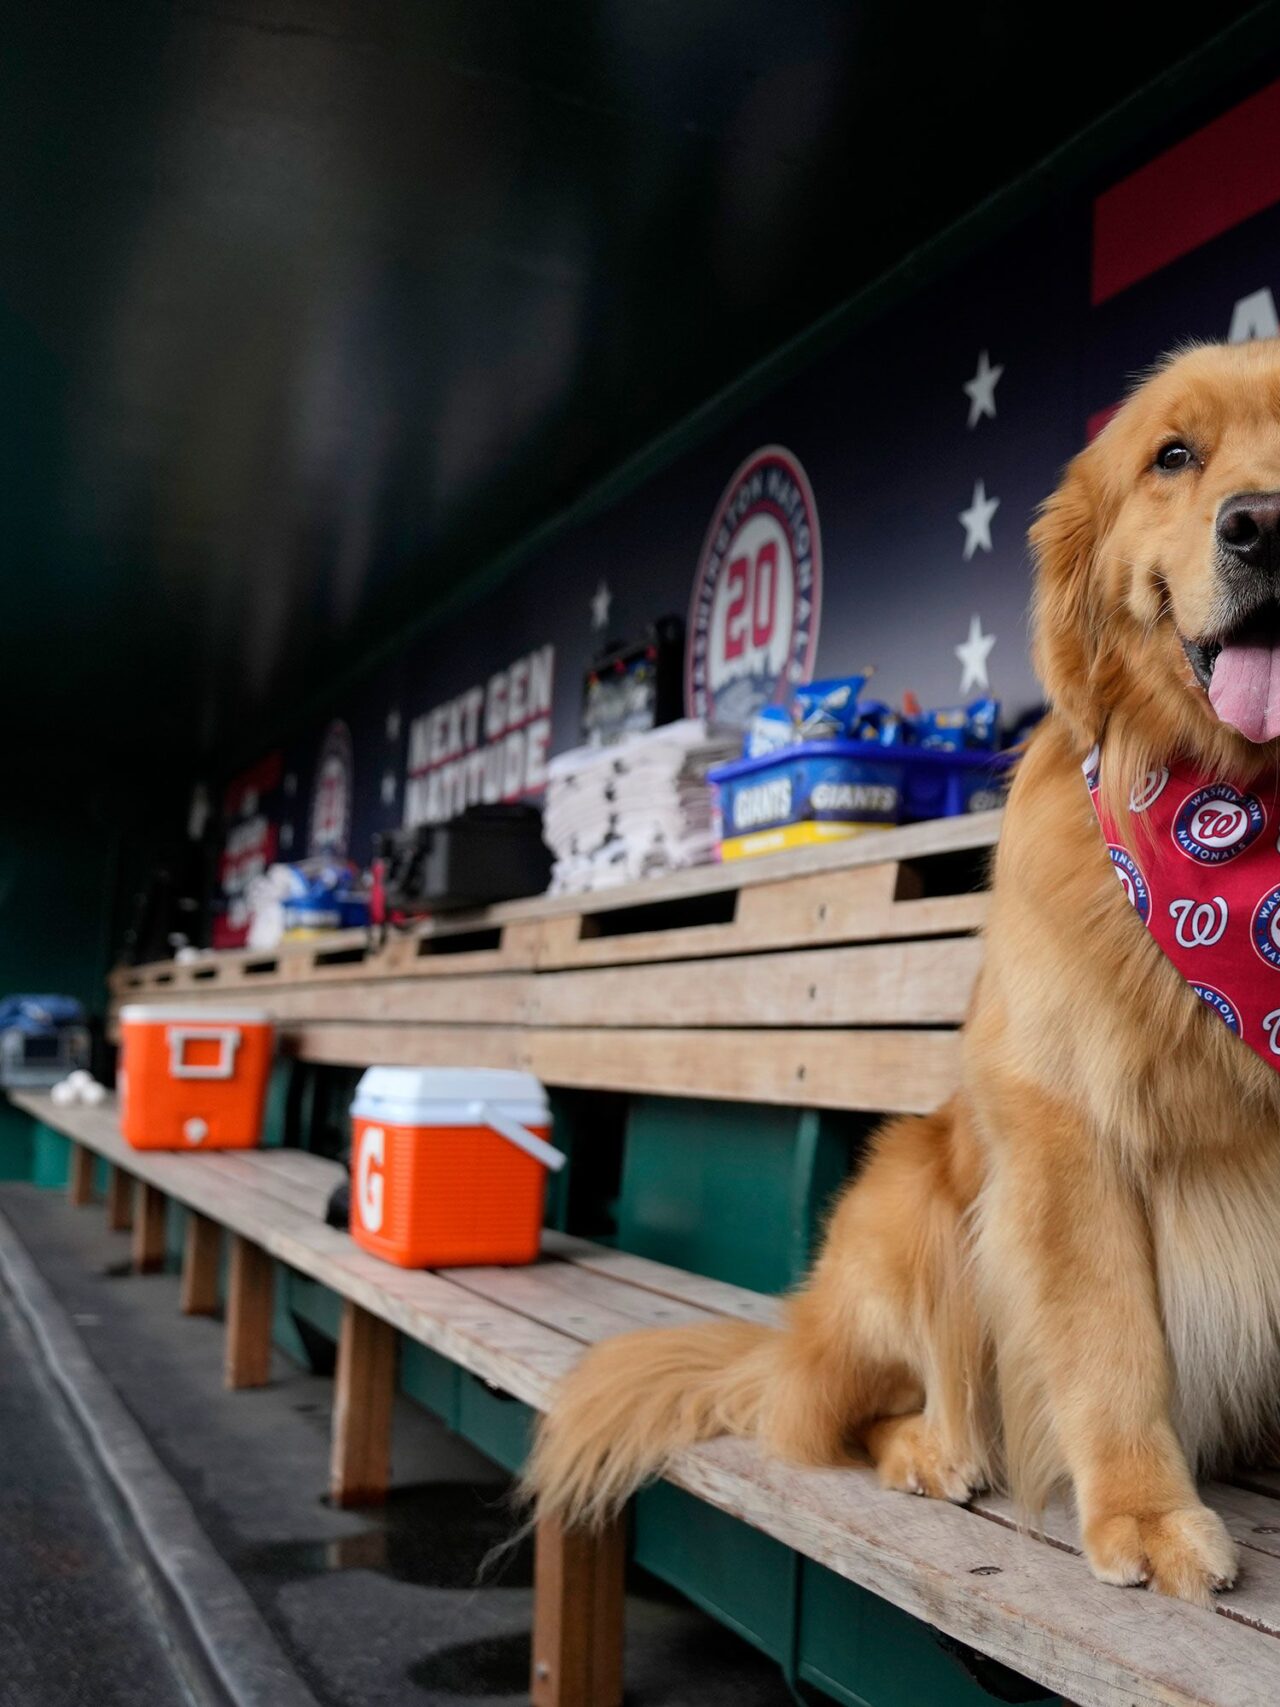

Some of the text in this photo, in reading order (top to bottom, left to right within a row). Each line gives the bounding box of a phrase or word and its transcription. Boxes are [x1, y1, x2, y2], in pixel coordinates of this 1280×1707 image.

[724, 540, 776, 660] 20
[408, 644, 554, 775] NEXT GEN
[1177, 830, 1246, 861] NATIONALS
[1198, 808, 1243, 840] W
[1168, 896, 1228, 949] W
[357, 1126, 385, 1233] G
